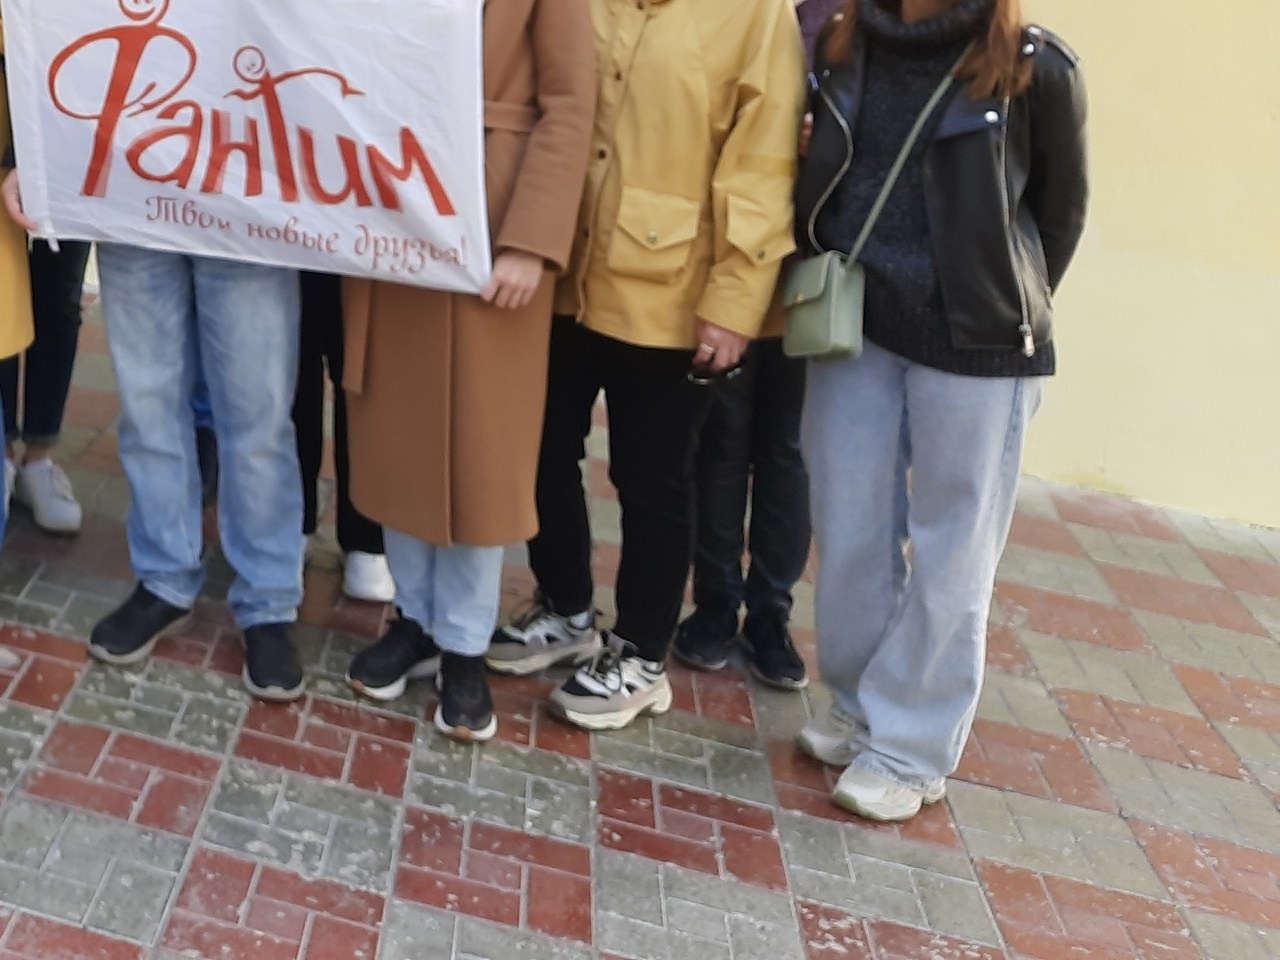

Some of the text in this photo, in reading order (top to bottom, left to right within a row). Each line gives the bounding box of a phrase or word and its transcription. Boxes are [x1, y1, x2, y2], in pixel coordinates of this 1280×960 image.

[145, 195, 468, 273] Твои новые друзья!
